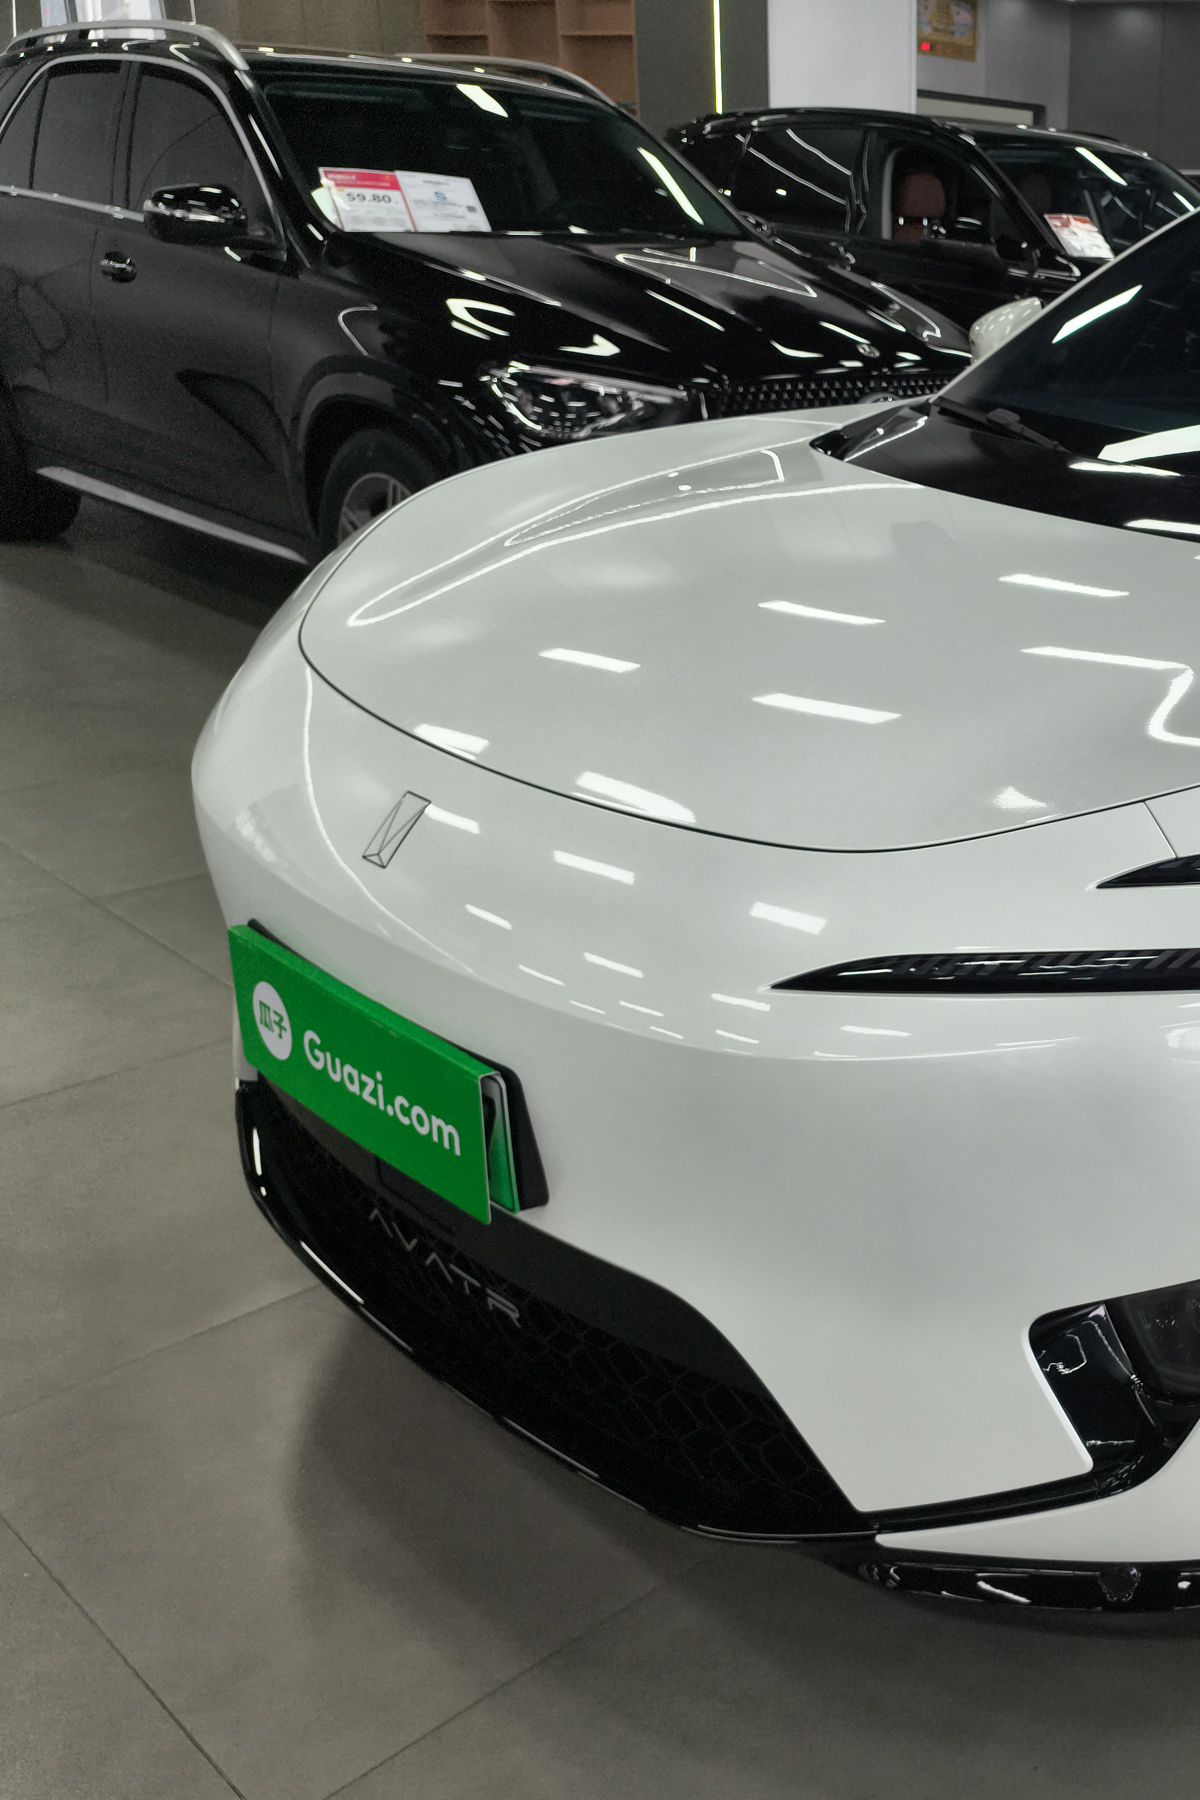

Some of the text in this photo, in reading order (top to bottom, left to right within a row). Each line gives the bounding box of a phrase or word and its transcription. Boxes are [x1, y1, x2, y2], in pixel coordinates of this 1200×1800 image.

[259, 1001, 287, 1040] 瓜子
[304, 1030, 461, 1157] Guazi.com
[369, 1207, 522, 1329] AVATR
